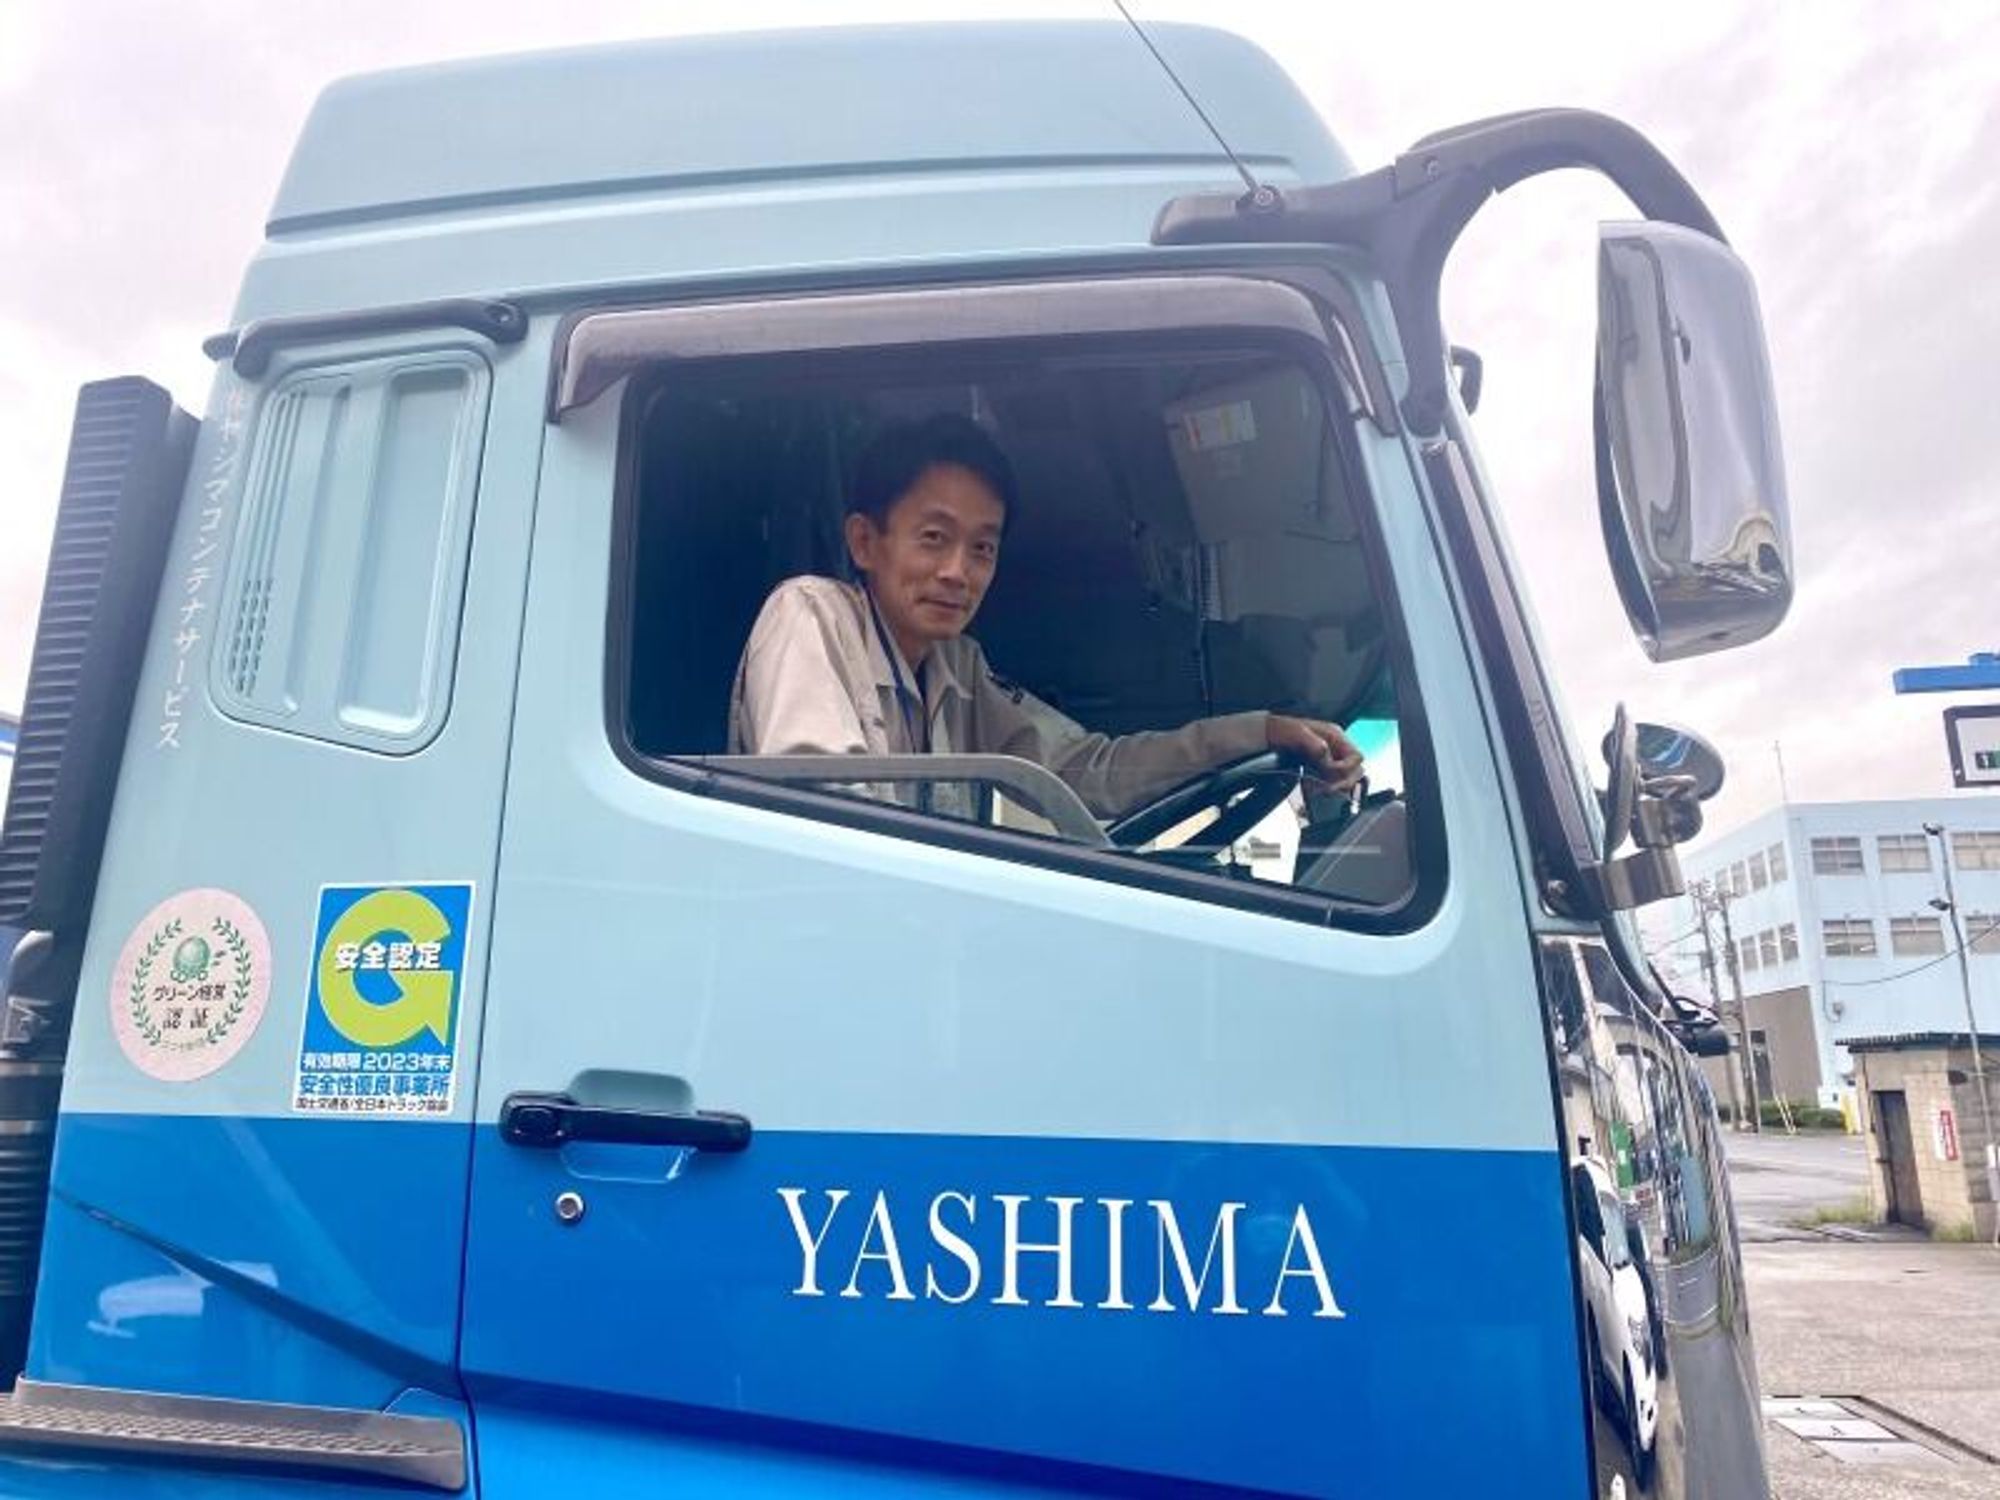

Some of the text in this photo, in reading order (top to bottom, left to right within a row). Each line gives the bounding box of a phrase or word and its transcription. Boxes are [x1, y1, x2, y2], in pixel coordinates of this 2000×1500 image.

[335, 942, 442, 971] 安全認定
[299, 1075, 450, 1097] 安全性優良事業所
[777, 1187, 1346, 1319] YASHIMA
